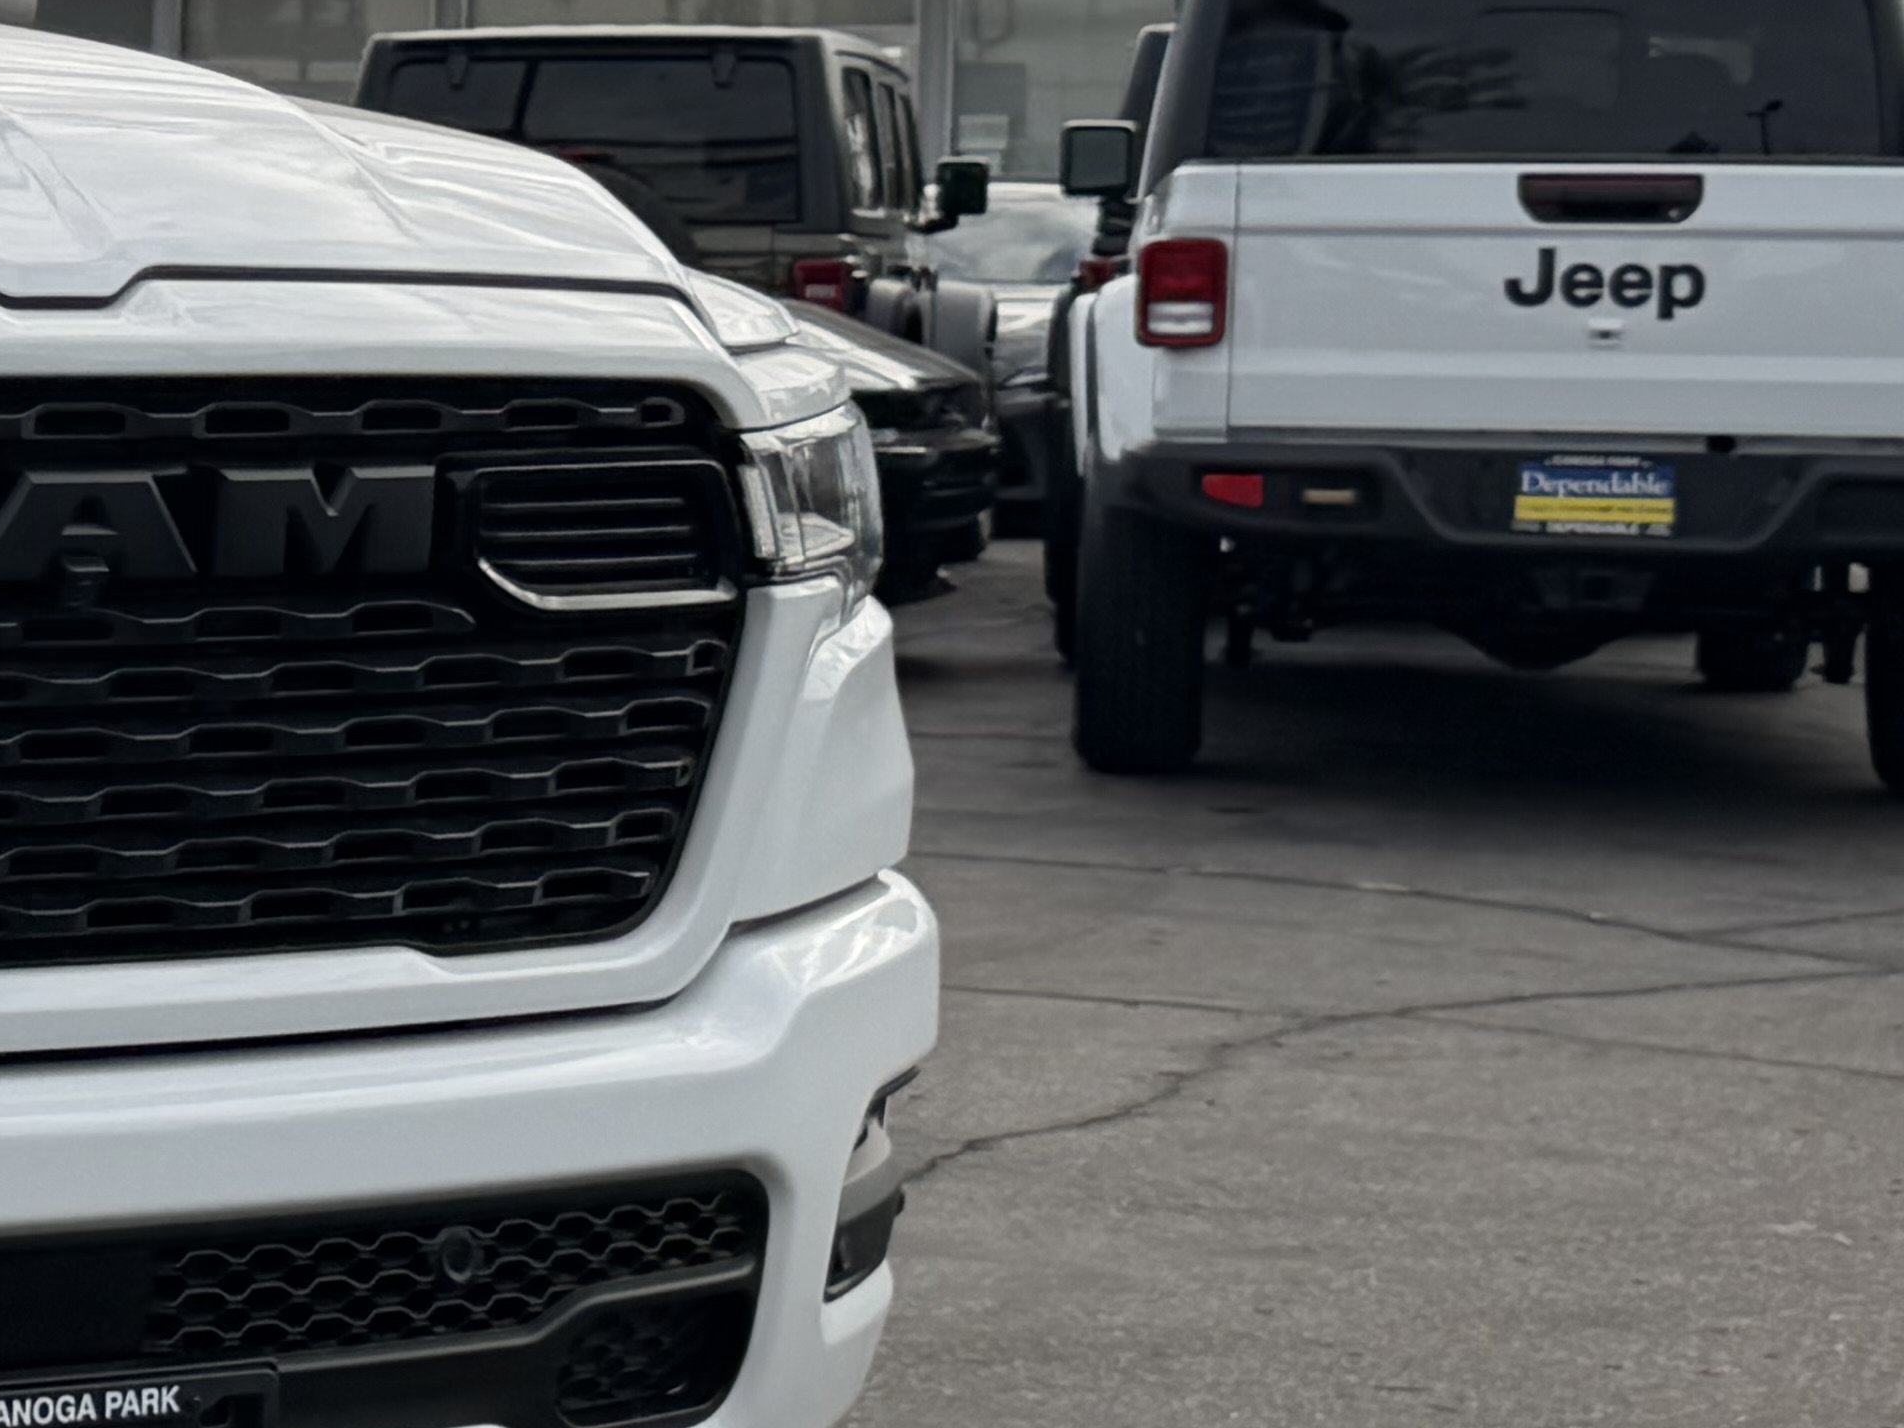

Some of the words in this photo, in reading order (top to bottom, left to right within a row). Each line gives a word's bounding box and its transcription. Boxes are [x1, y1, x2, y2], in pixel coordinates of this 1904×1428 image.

[1504, 246, 1706, 320] Jeep
[1520, 470, 1668, 499] Dependable
[104, 1385, 181, 1420] PARK
